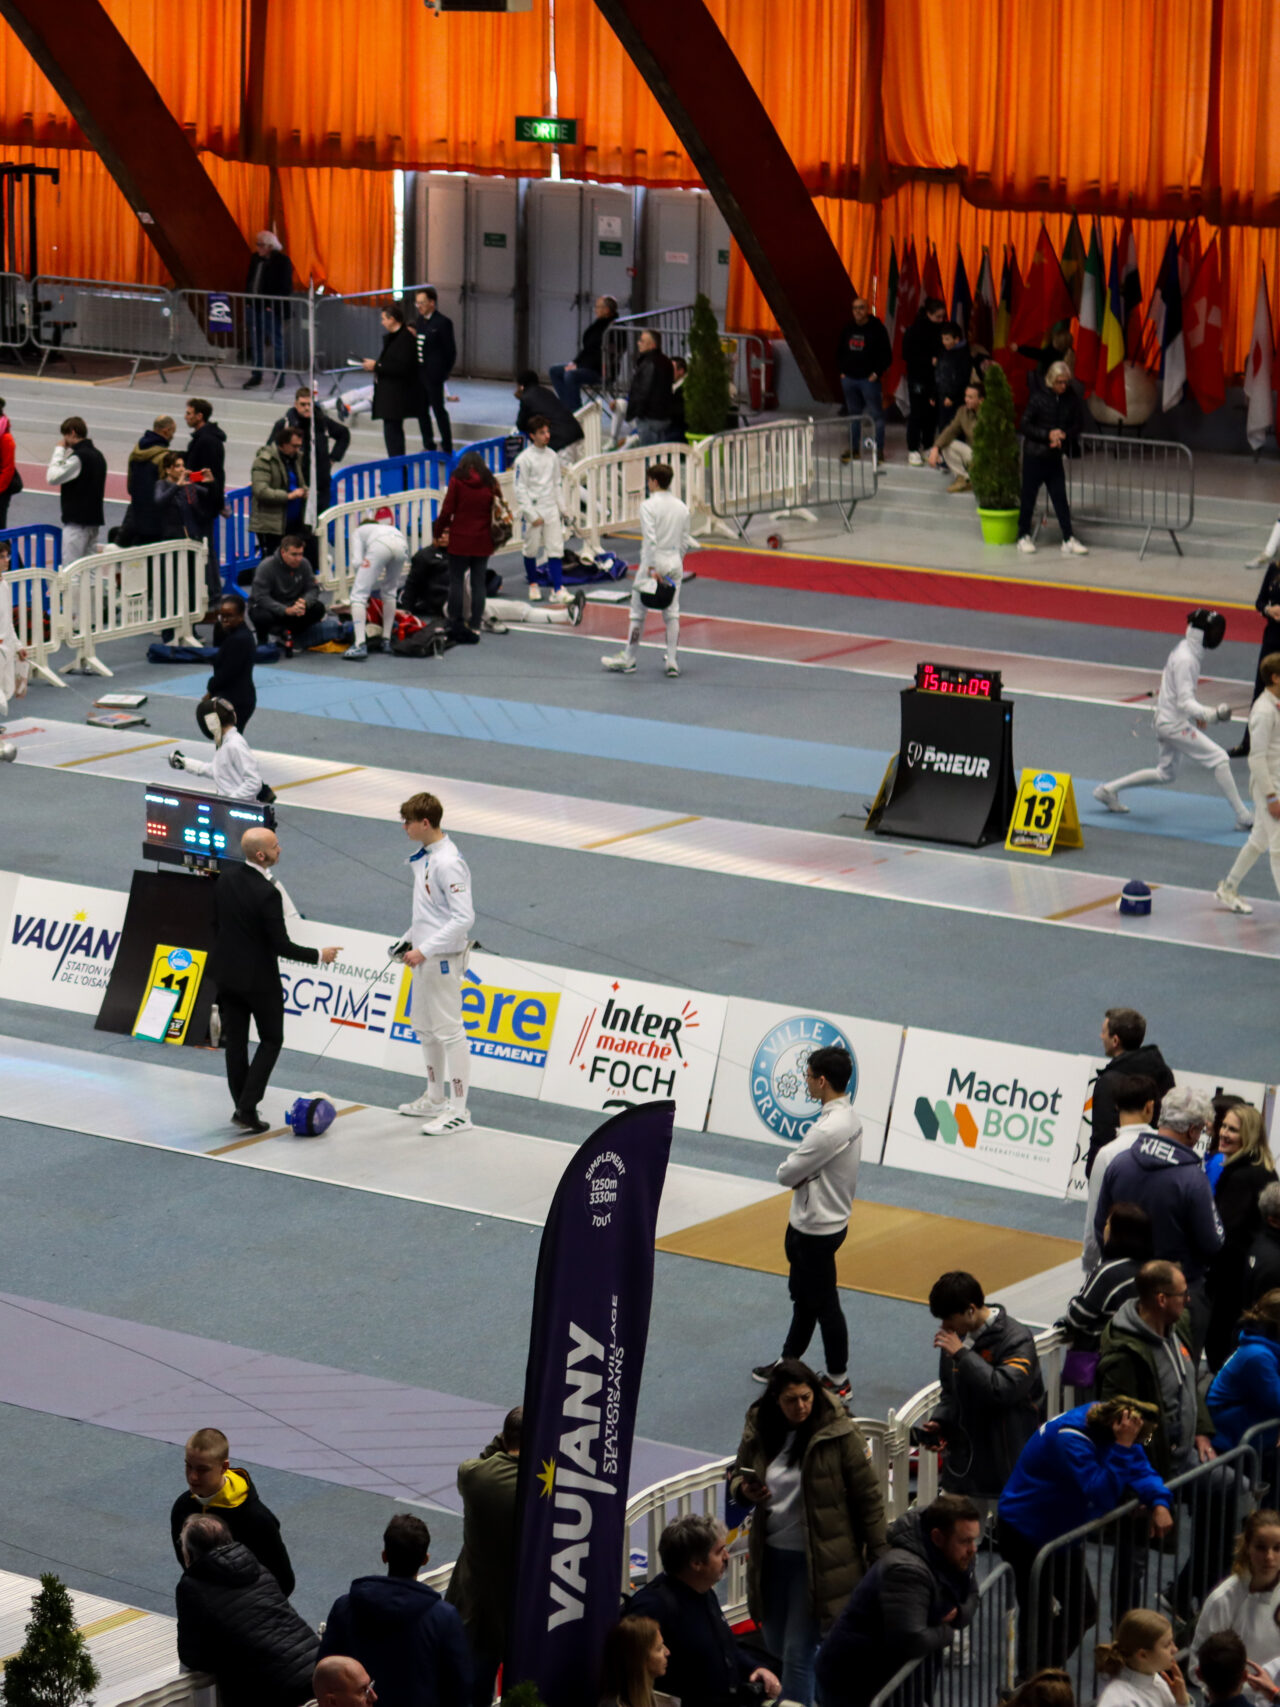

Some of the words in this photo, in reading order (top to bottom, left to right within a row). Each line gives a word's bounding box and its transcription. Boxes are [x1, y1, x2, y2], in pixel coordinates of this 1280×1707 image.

[523, 122, 569, 139] SORTIE
[924, 674, 939, 691] 15
[968, 678, 990, 696] 09
[922, 749, 990, 778] PRIEUR
[1023, 795, 1055, 830] 13
[12, 914, 122, 981] VAUJAN
[61, 972, 74, 984] DE
[74, 974, 109, 990] L'OISAN
[66, 961, 102, 976] STATION
[332, 961, 397, 985] FRANÇAISE
[279, 973, 392, 1033] SCRIME
[392, 1025, 414, 1039] LE
[468, 1041, 546, 1066] RTEMENT
[763, 1020, 824, 1055] VILLE
[588, 1055, 676, 1098] FOCH
[946, 1067, 1062, 1116] Machot
[754, 1076, 817, 1138] GRENO
[982, 1108, 1056, 1147] BOIS
[586, 1152, 626, 1181] SIMPLEMENT
[1140, 1138, 1180, 1165] KIEL
[589, 1190, 616, 1204] 3330m
[592, 1178, 618, 1192] 1250m
[592, 1212, 612, 1227] TOUT
[608, 1294, 618, 1382] VILLAGE
[611, 1346, 624, 1441] L'OISANS
[603, 1388, 614, 1474] STATION
[548, 1320, 617, 1632] VAUJANY
[611, 1447, 618, 1474] DE
